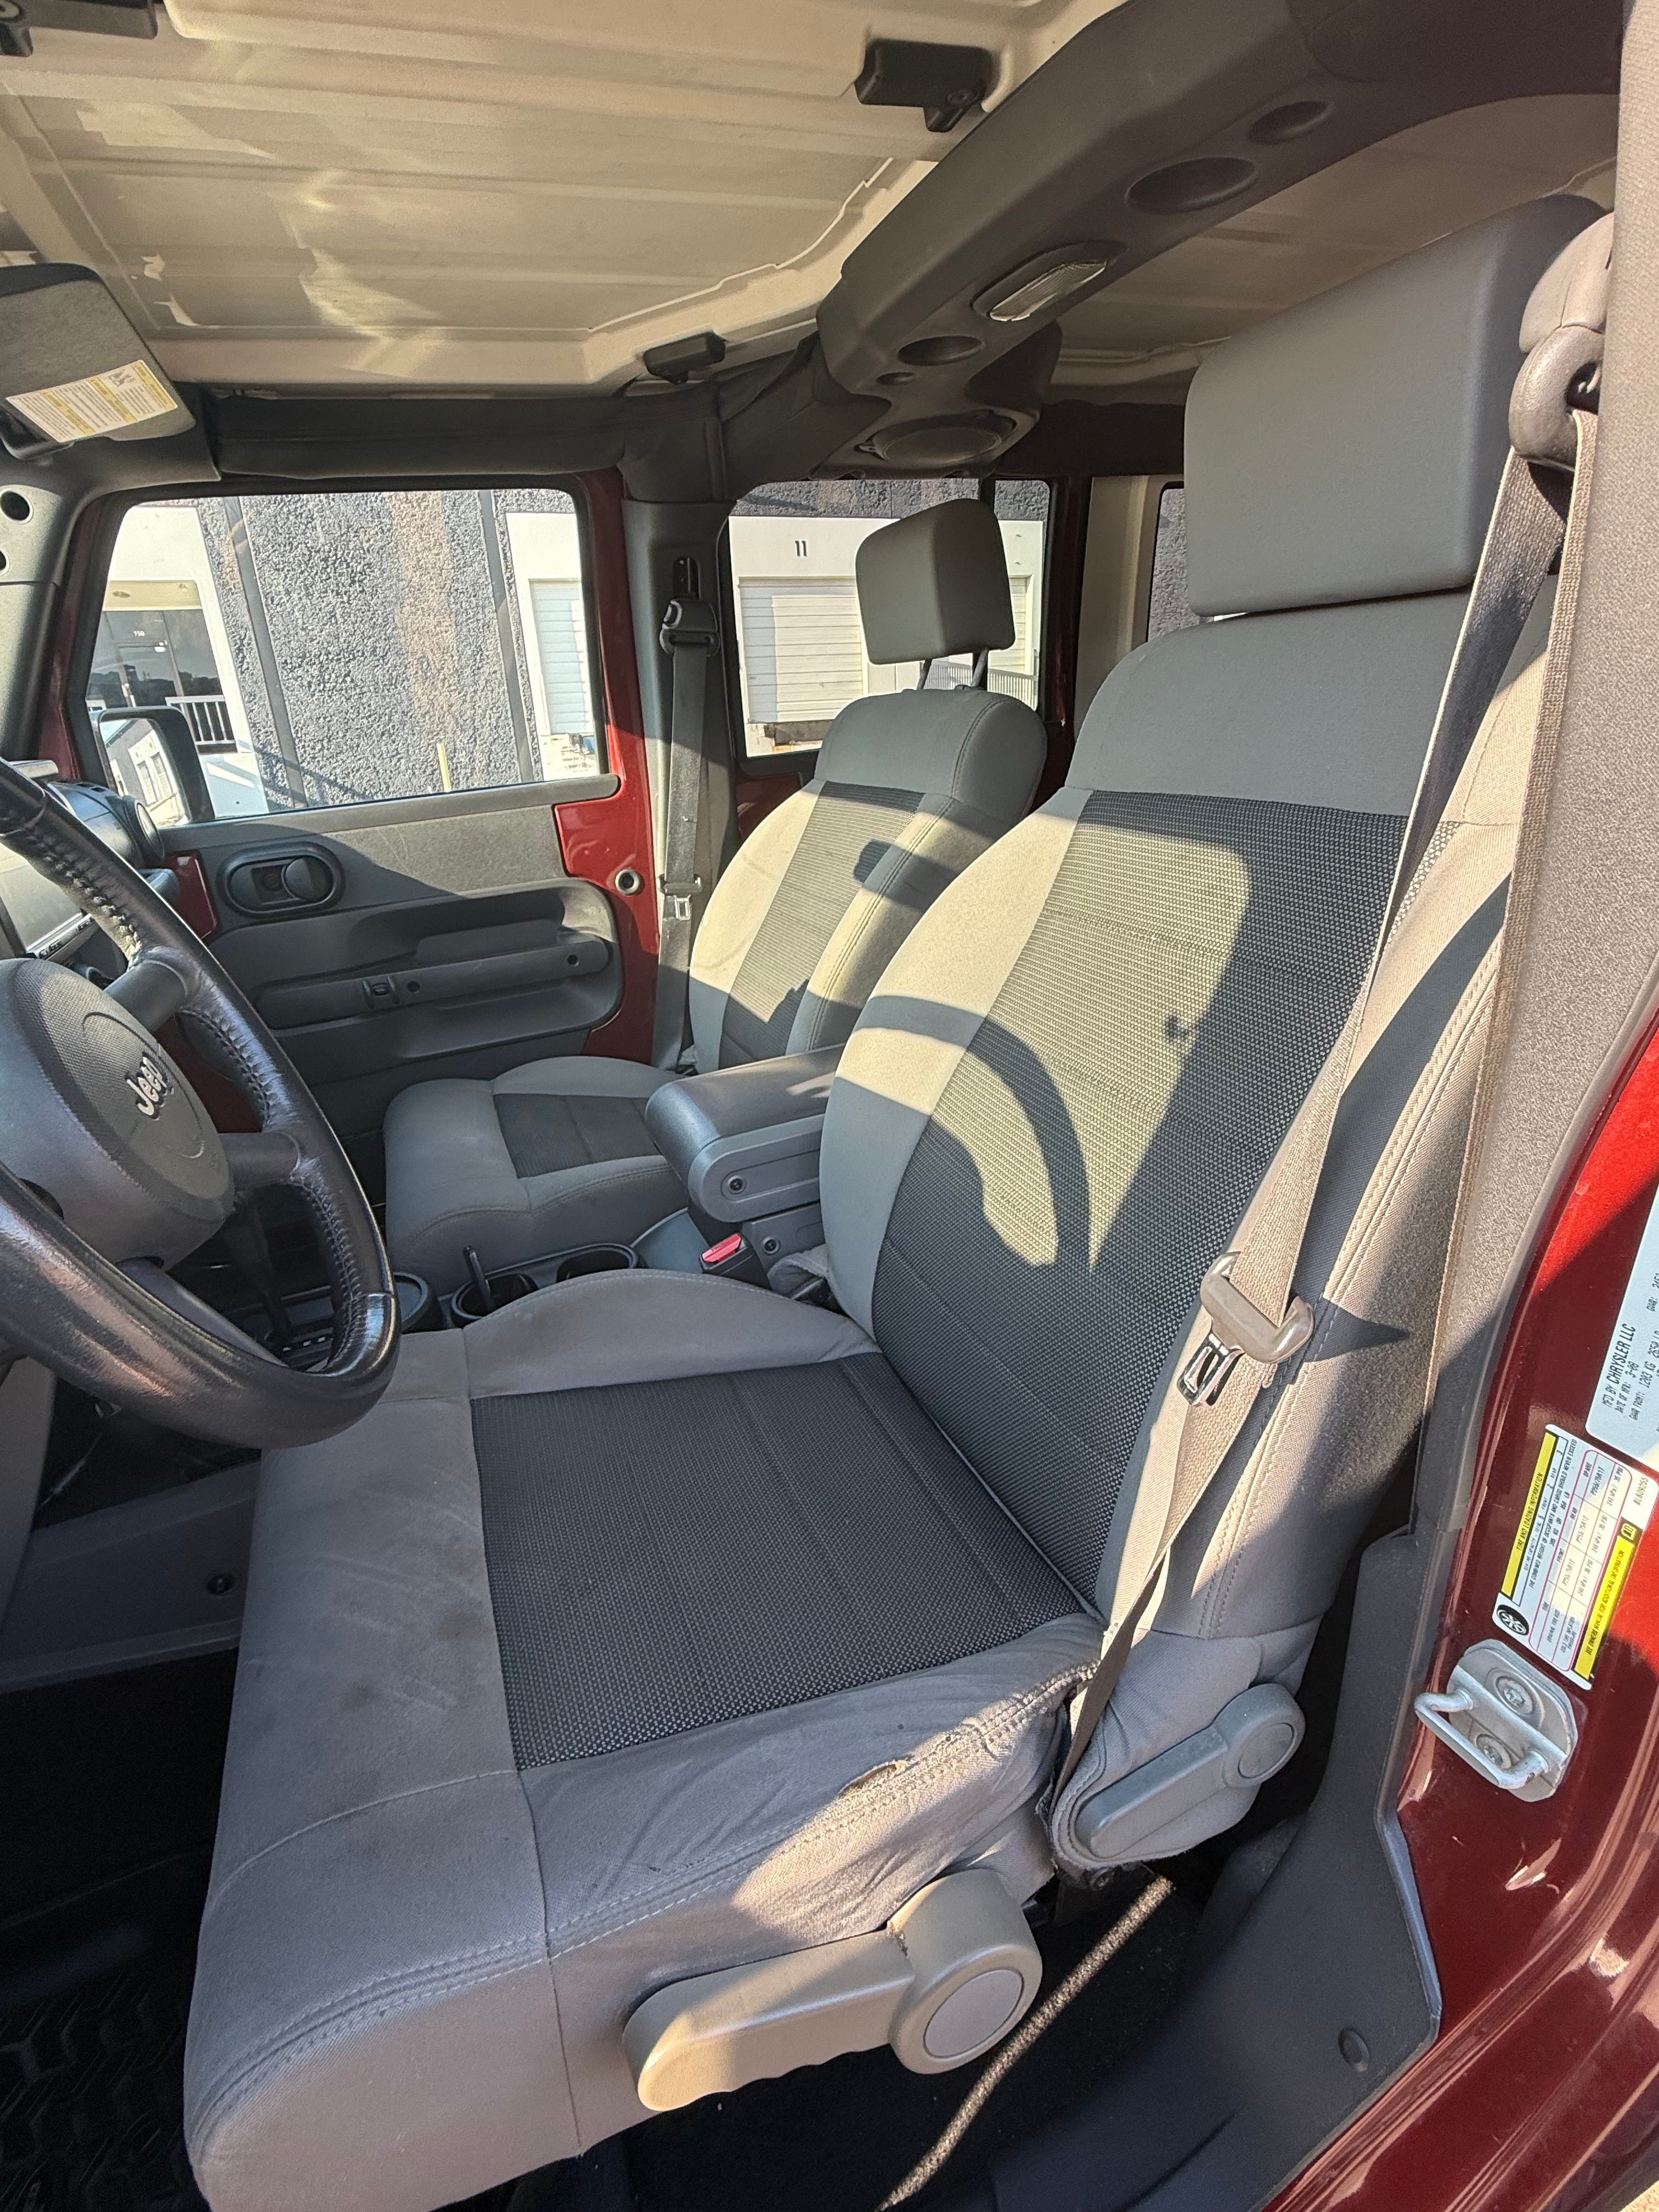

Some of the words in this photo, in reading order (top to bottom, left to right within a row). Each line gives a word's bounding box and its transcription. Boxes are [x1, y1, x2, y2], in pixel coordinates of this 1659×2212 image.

[795, 540, 808, 557] 11
[127, 1057, 167, 1116] Jeep
[1620, 1323, 1636, 1342] LLC
[1606, 1340, 1631, 1385] CHRYSLER
[1644, 1361, 1656, 1372] KG
[1605, 1384, 1617, 1395] BY
[1602, 1394, 1615, 1408] MFD
[1567, 1438, 1577, 1457] EXCEED
[1563, 1456, 1572, 1471] NEVER
[1558, 1470, 1567, 1489] SHOULD
[1523, 1505, 1533, 1528] LOADING
[1529, 1472, 1543, 1506] INFORMATION
[1556, 1547, 1565, 1563] FRONT
[1582, 1461, 1592, 1477] SPARE
